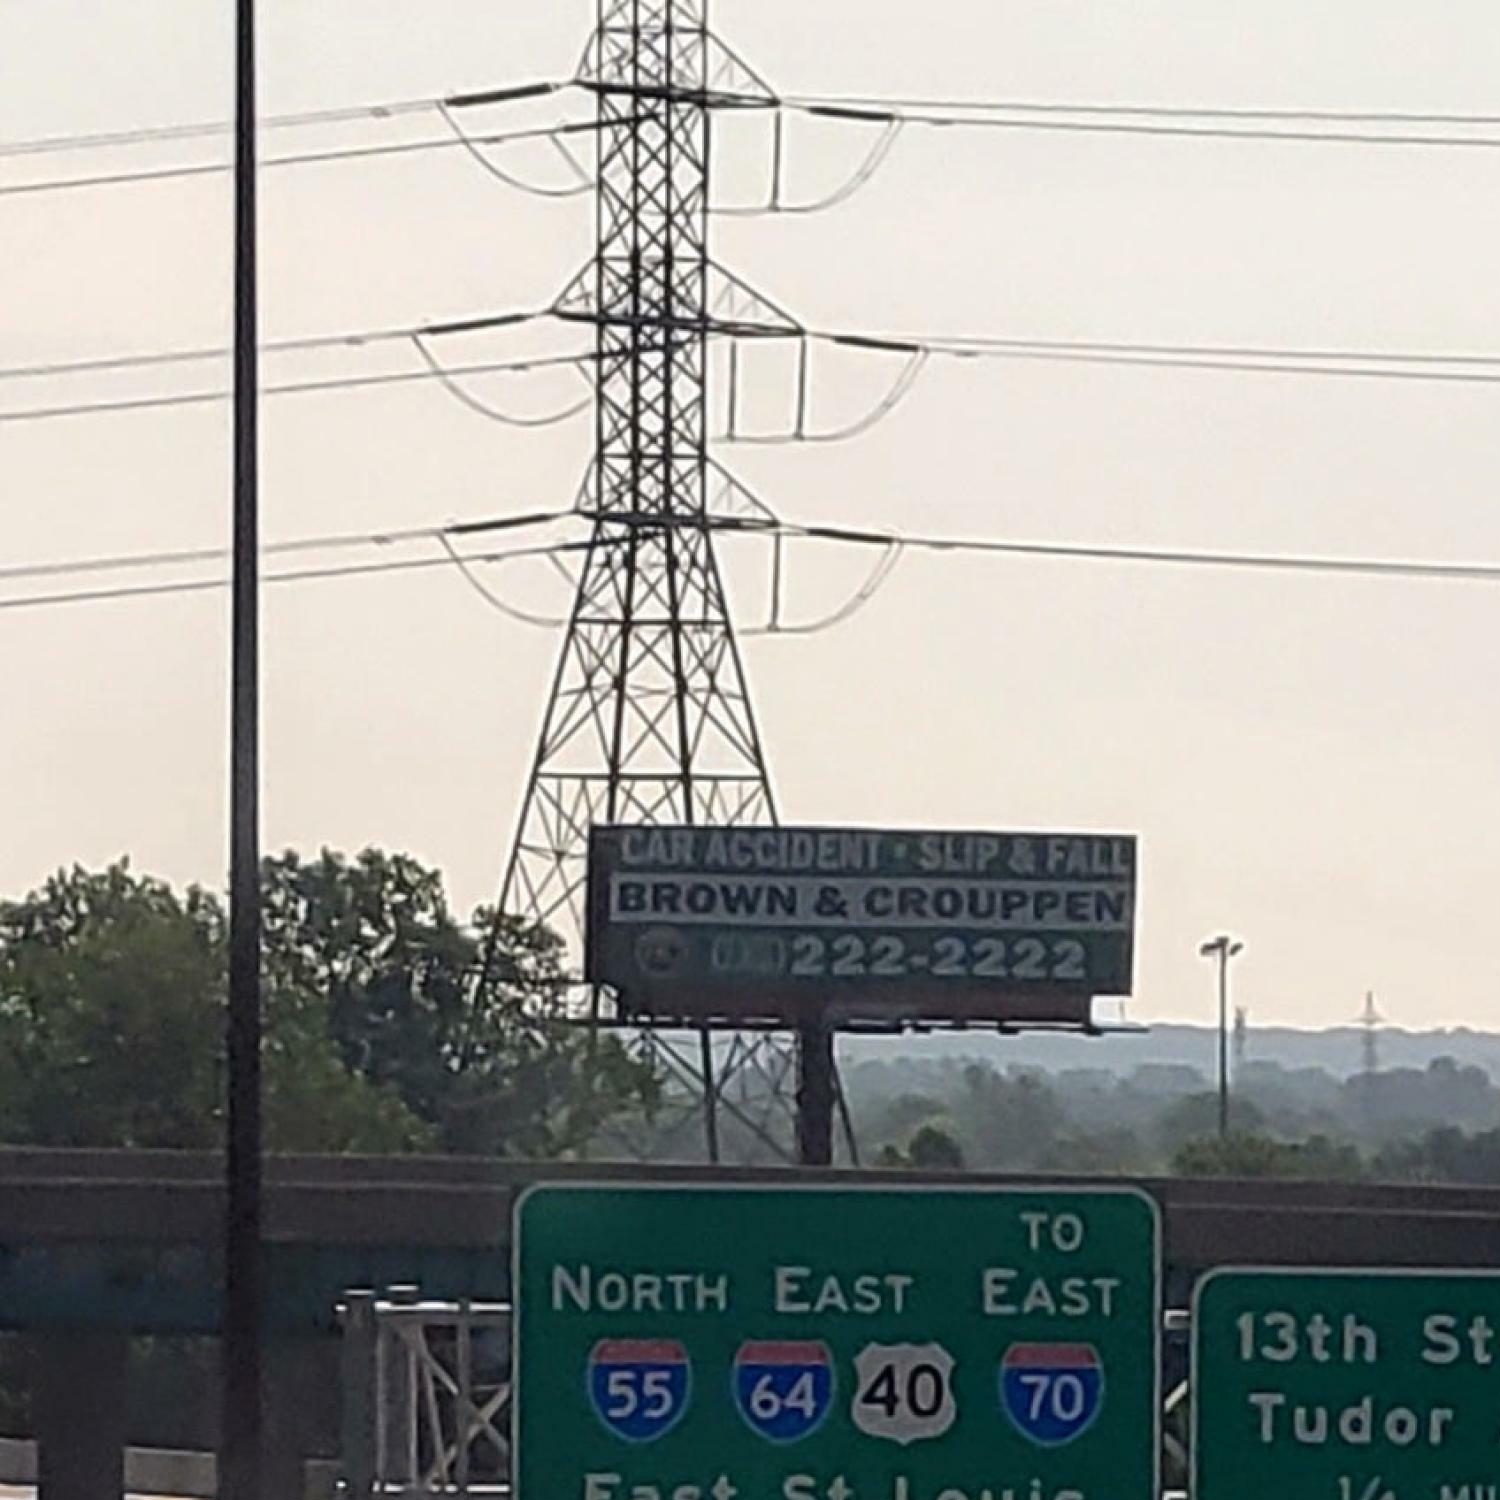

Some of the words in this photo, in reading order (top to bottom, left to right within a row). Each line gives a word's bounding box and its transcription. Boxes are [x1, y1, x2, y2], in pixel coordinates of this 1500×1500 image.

[621, 834, 697, 866] CAR
[702, 834, 879, 871] ACCIDENT
[919, 838, 996, 871] SLIP
[1008, 838, 1037, 872] &
[1047, 840, 1129, 875] FALL
[617, 881, 797, 916] BROWN
[814, 885, 848, 918] &
[865, 886, 1126, 922] CROUPPEN
[1021, 1212, 1084, 1251] TO
[552, 1263, 728, 1312] NORTH
[774, 1266, 913, 1313] EAST
[982, 1268, 1121, 1316] EAST
[1236, 1311, 1377, 1364] 13th
[606, 1371, 674, 1419] 55
[749, 1372, 817, 1420] 64
[861, 1364, 944, 1419] 40
[1019, 1374, 1084, 1421] 70
[1248, 1393, 1453, 1446] Tudor
